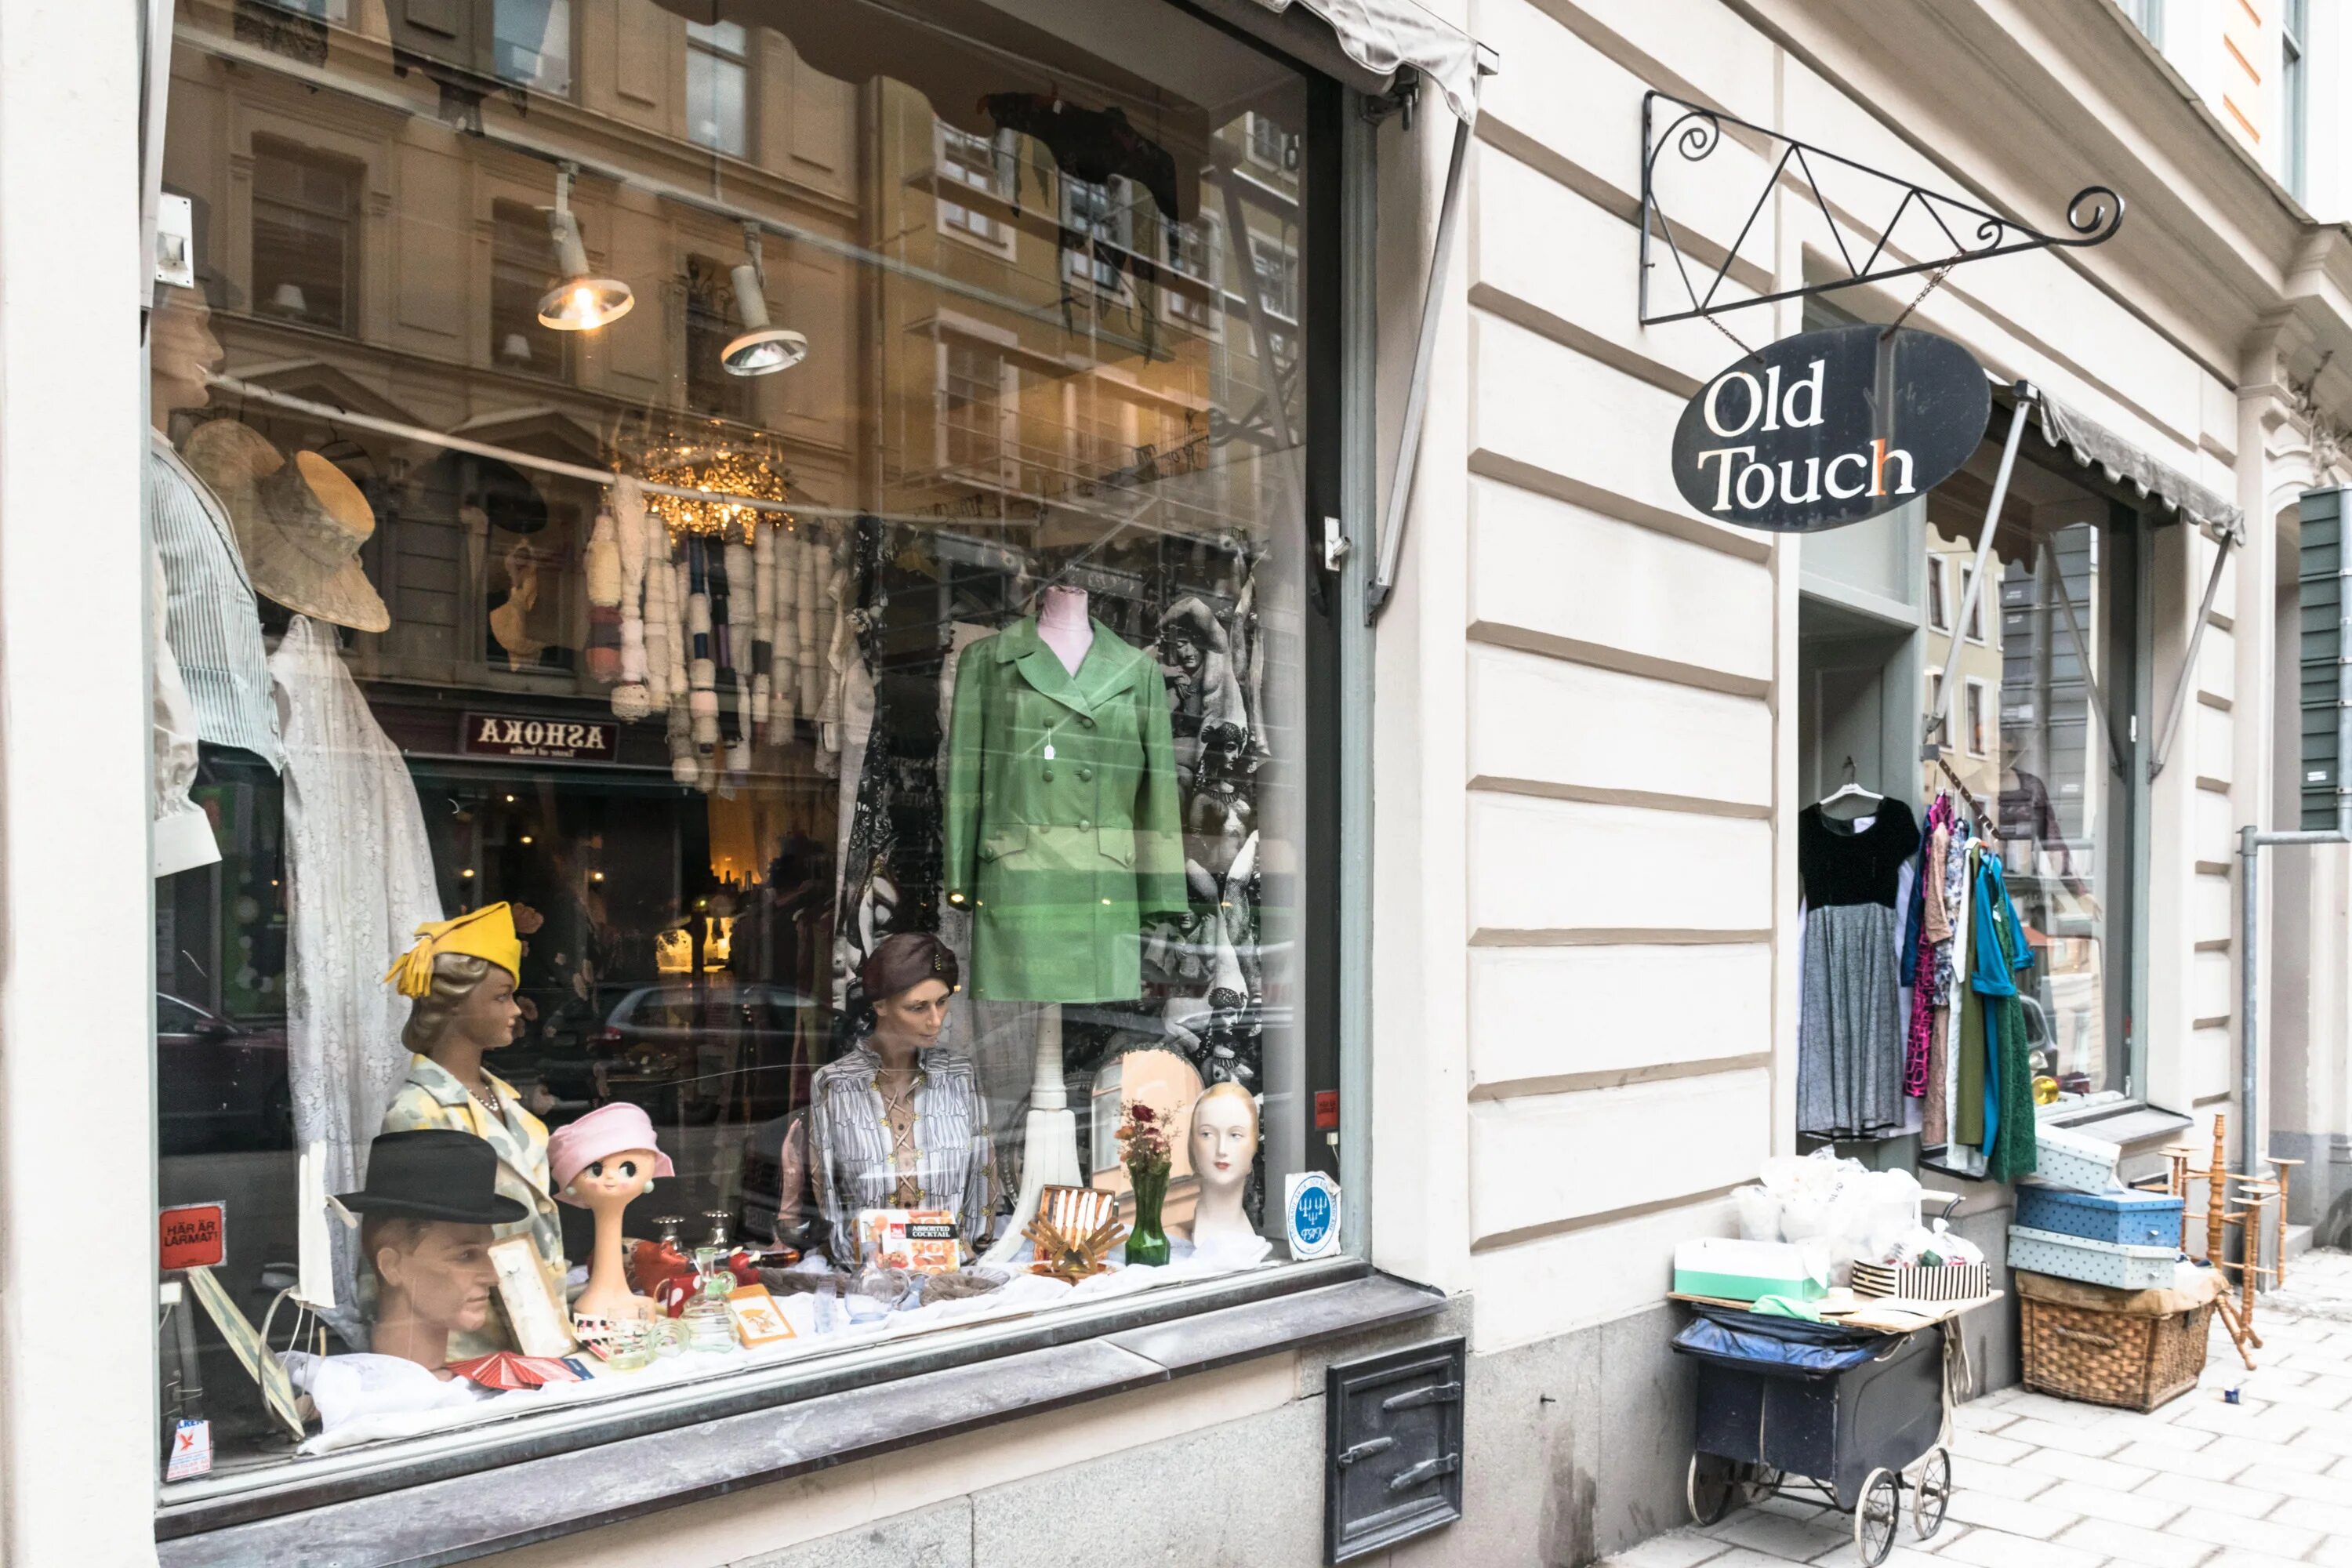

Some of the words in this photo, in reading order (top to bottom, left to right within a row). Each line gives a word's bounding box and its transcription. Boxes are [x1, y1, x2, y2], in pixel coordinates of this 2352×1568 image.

[1704, 359, 1825, 437] Old
[1697, 438, 1916, 512] Touch
[168, 1221, 195, 1235] HÄR
[198, 1219, 216, 1232] ÄR
